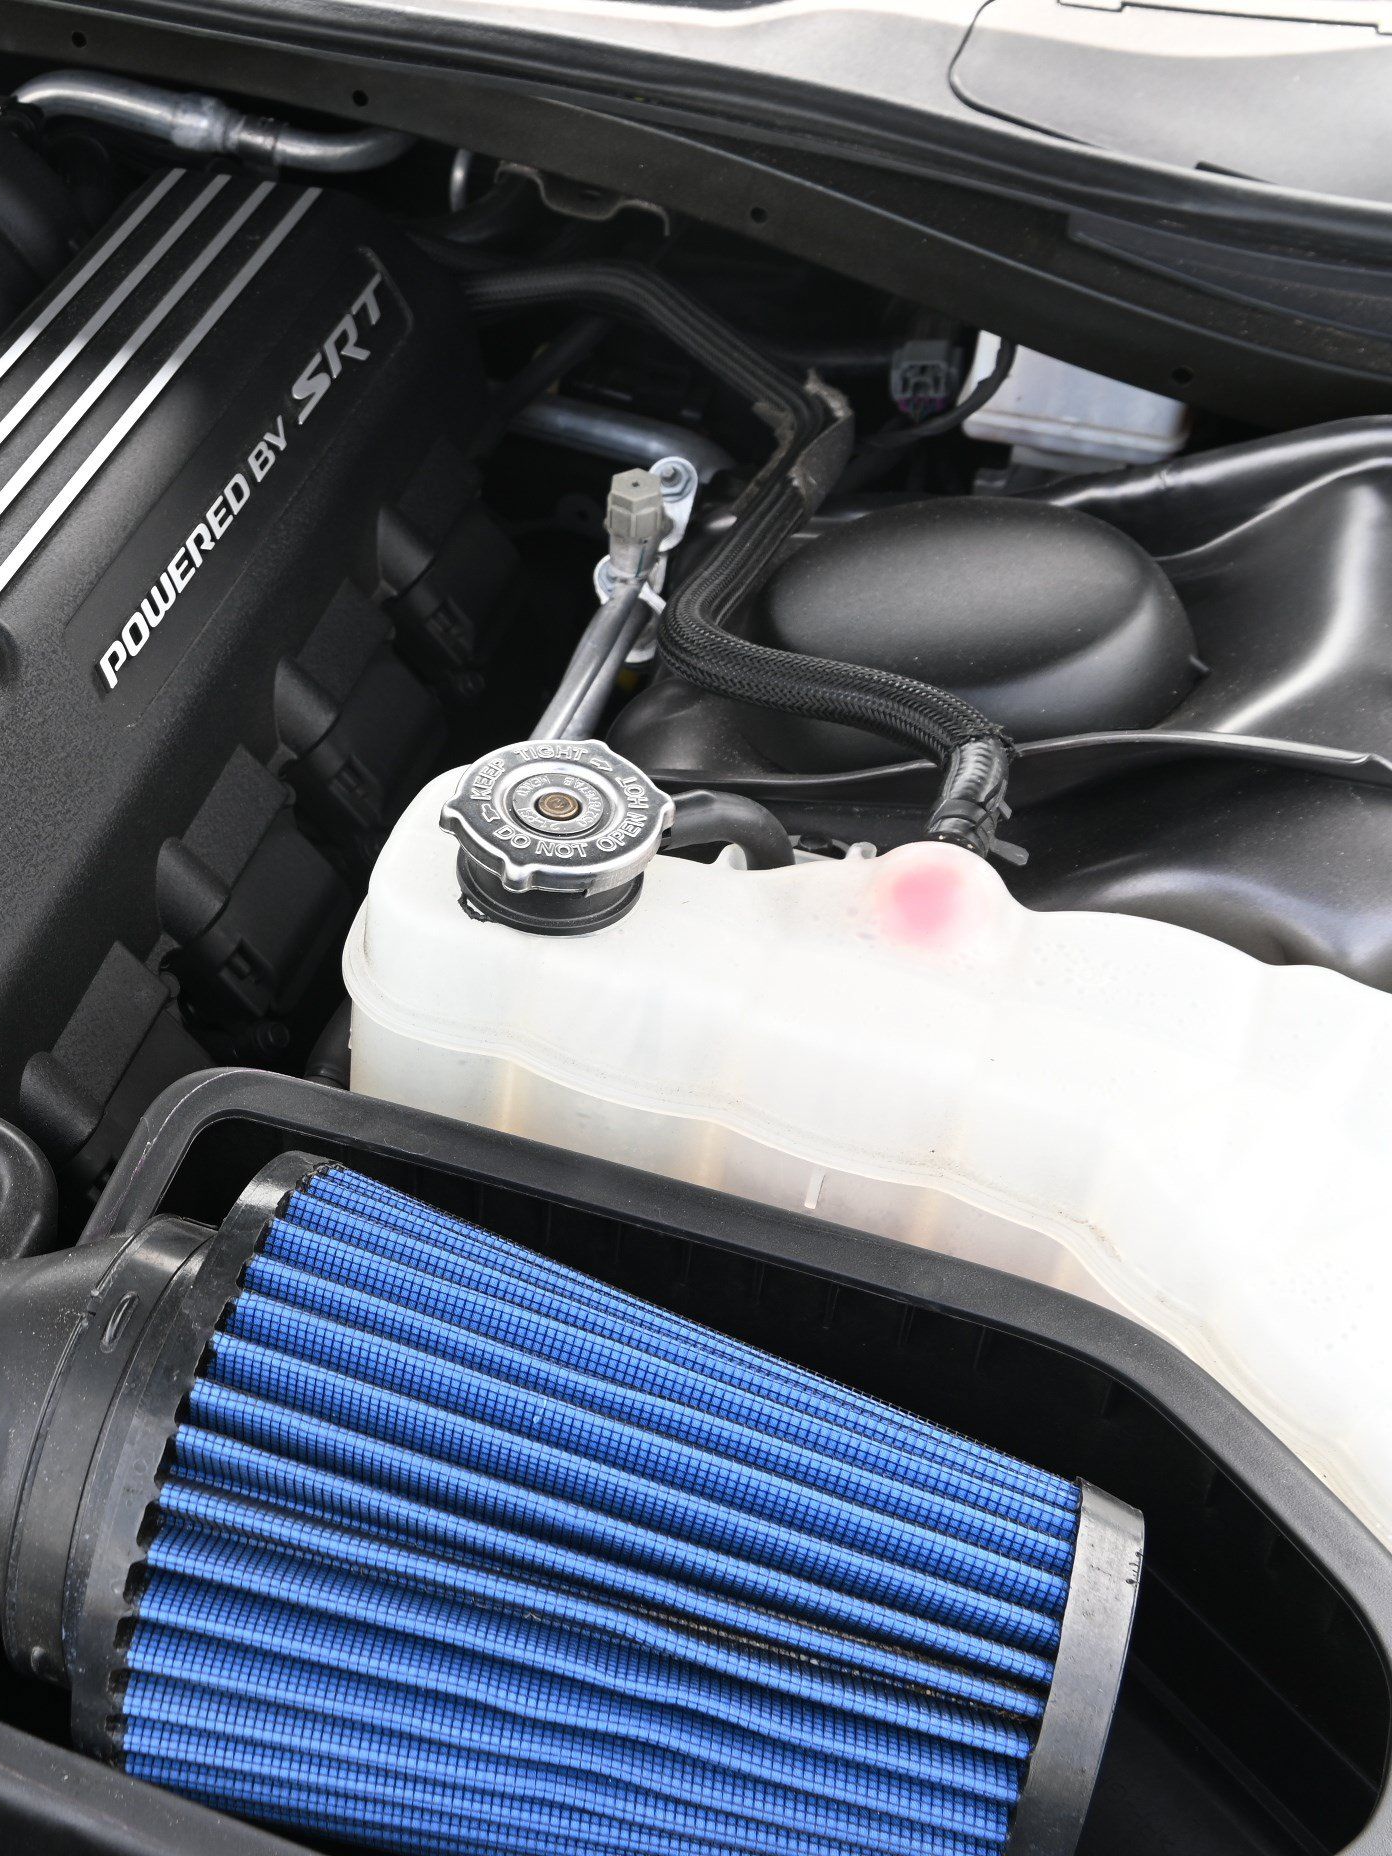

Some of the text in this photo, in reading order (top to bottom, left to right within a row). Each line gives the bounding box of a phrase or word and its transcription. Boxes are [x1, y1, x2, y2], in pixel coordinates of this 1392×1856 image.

[97, 272, 382, 689] POWERED BY SRT
[469, 745, 589, 801] KEEP TIGHT
[493, 774, 650, 859] DO NOT OPEN HOT
